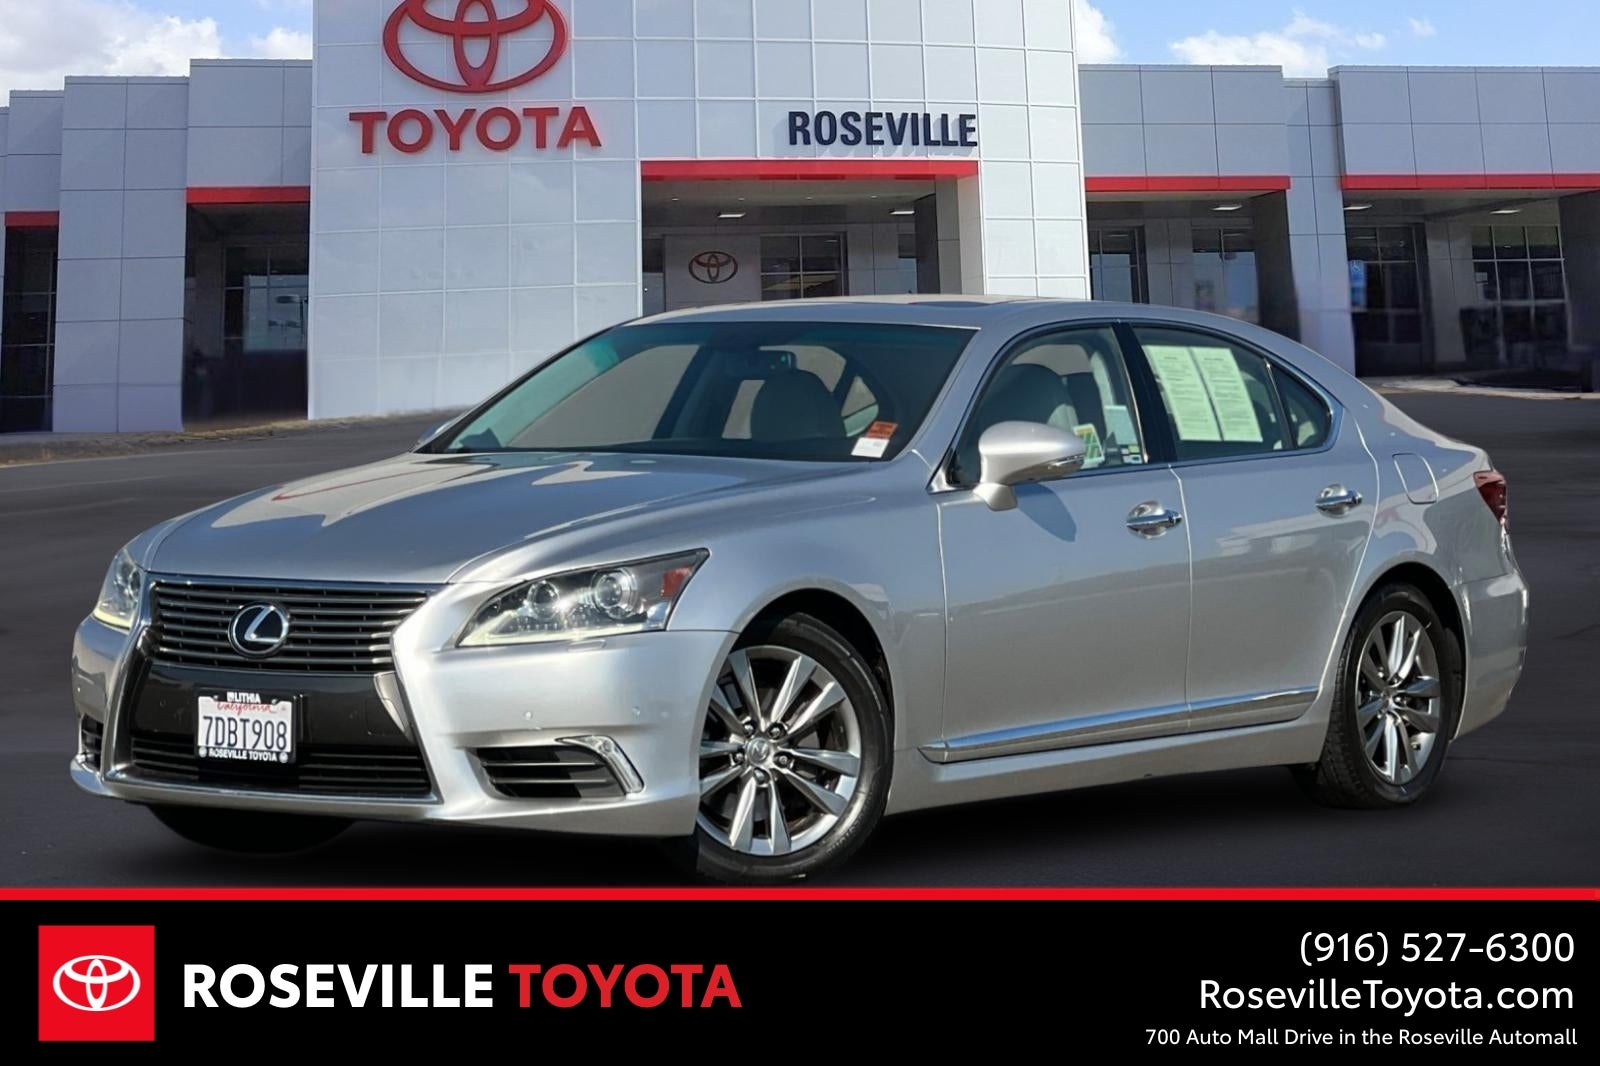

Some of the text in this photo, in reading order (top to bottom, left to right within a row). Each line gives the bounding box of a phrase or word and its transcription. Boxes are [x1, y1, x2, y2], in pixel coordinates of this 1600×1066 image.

[349, 105, 602, 154] TOYOTA
[788, 110, 978, 148] ROSEVILLE
[234, 692, 261, 704] LITHIA
[203, 716, 287, 750] 7DBT908
[209, 748, 277, 761] ROSEVILLE TOYOTA
